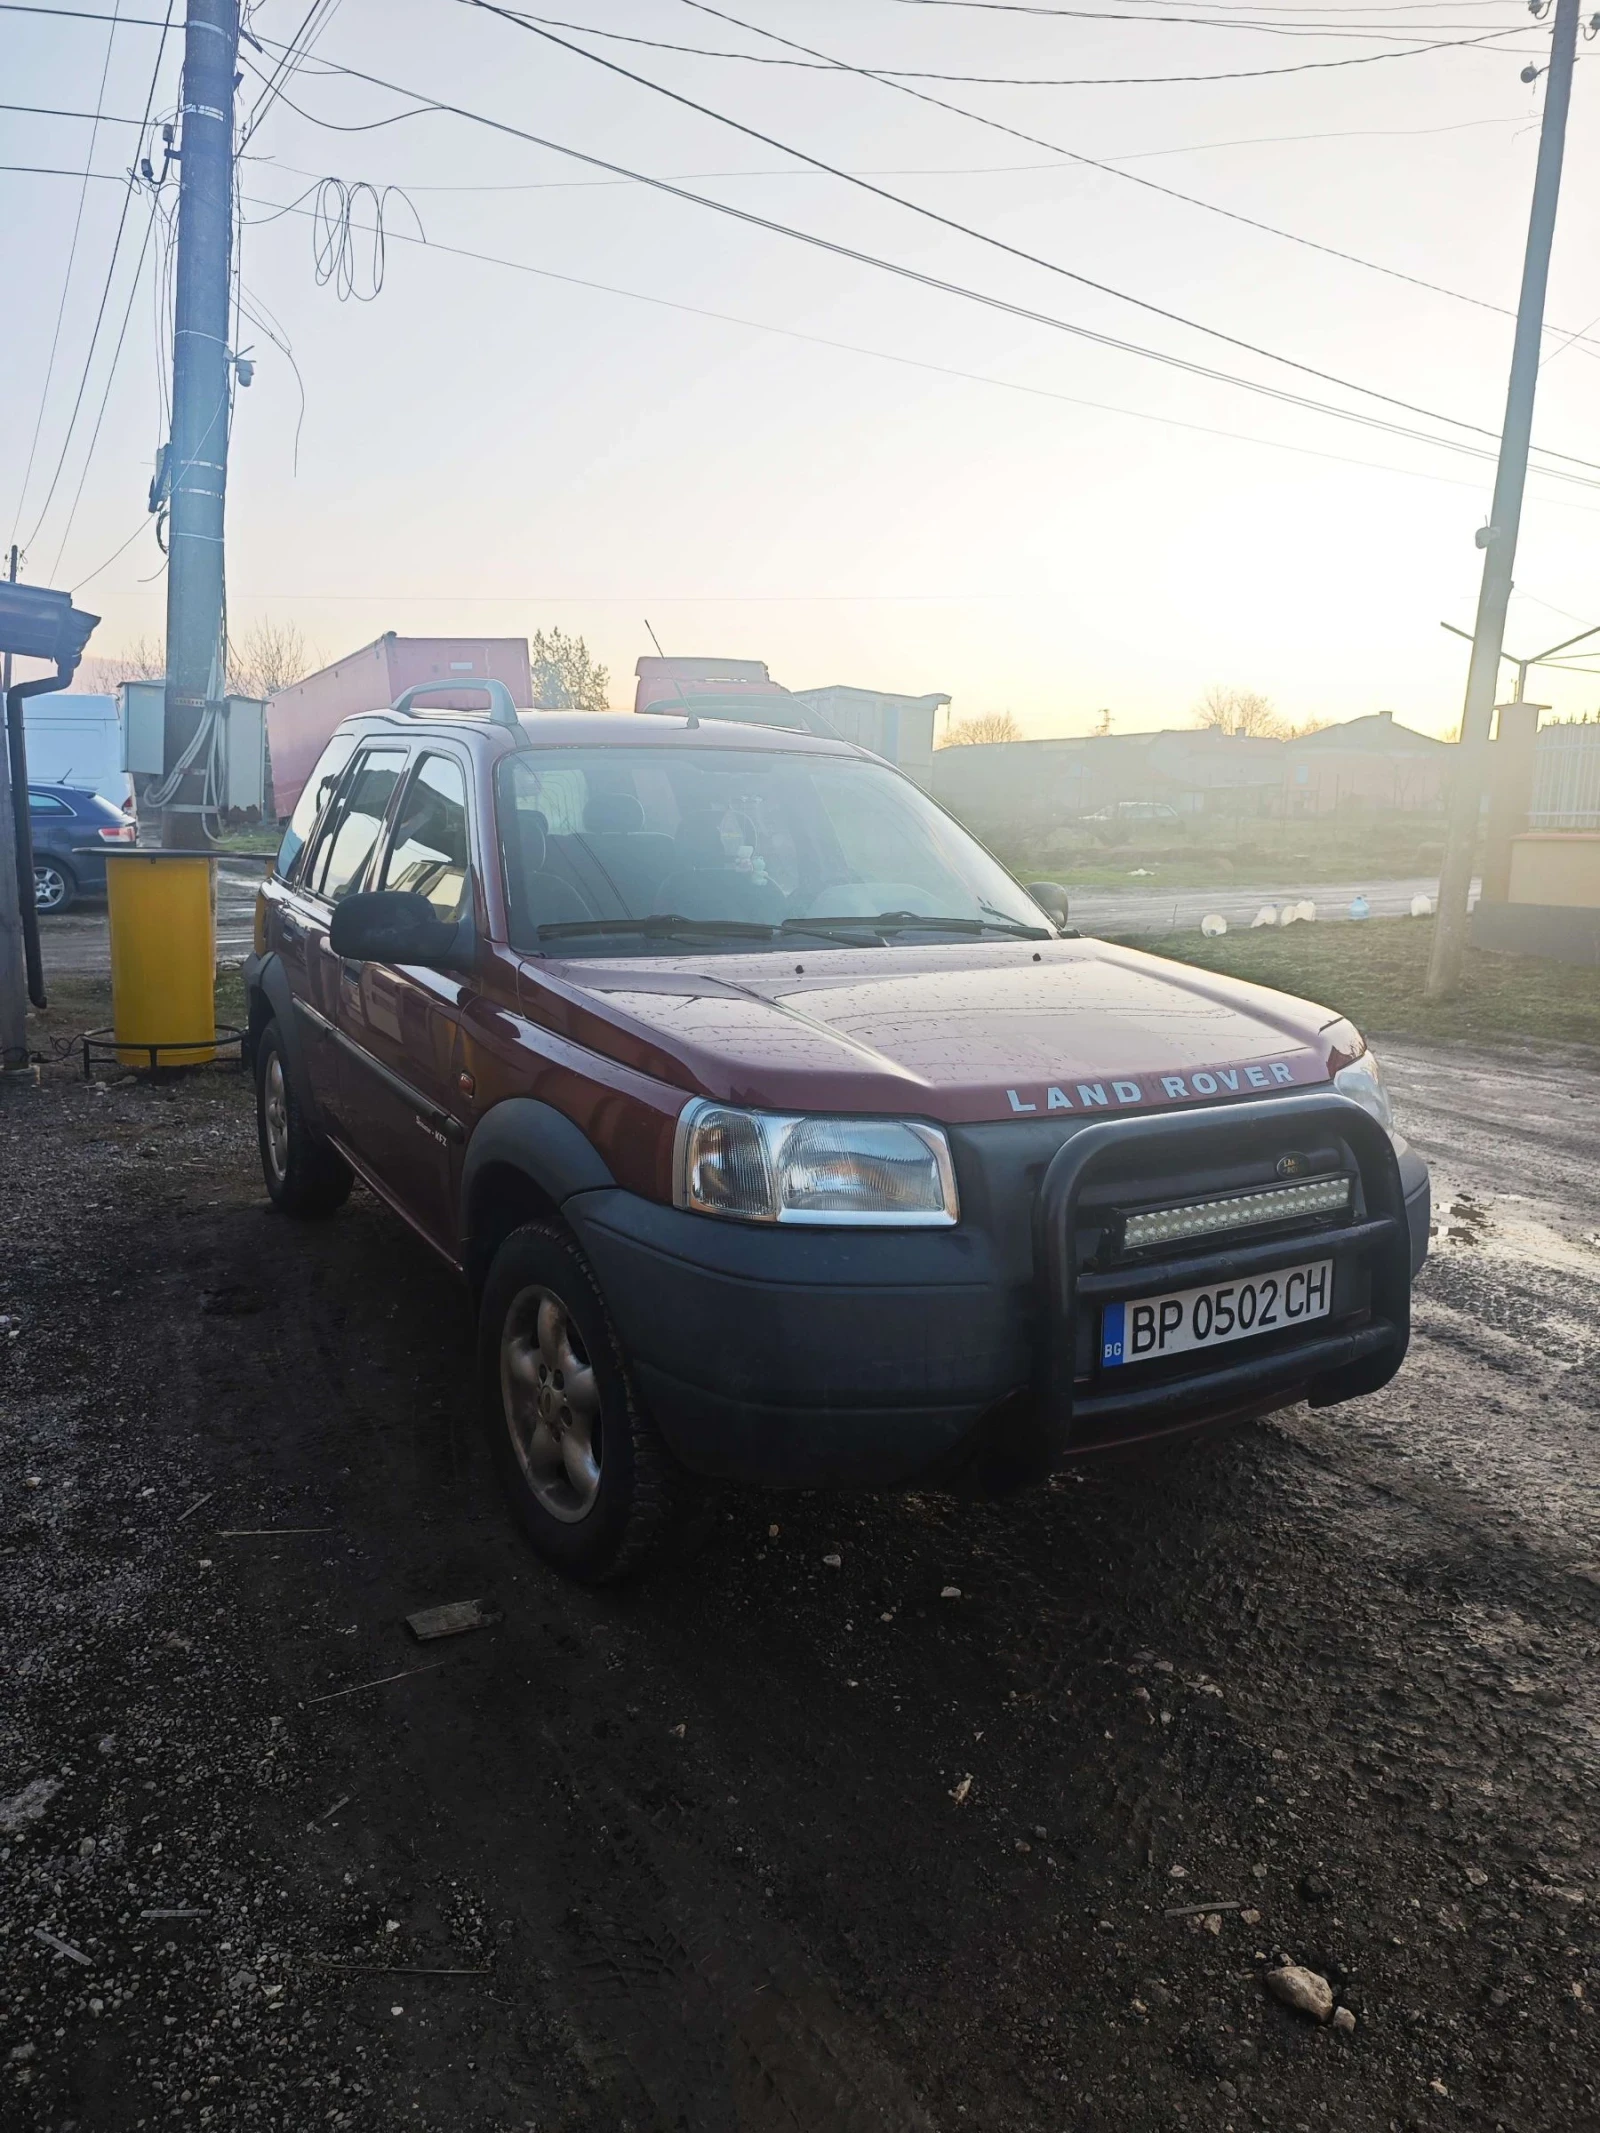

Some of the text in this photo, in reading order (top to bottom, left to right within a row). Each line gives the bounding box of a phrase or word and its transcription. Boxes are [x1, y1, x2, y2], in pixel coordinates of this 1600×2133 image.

[1006, 1062, 1294, 1112] LAND ROVER
[1131, 1265, 1327, 1355] BP 0502 CH
[1104, 1342, 1122, 1358] BG
